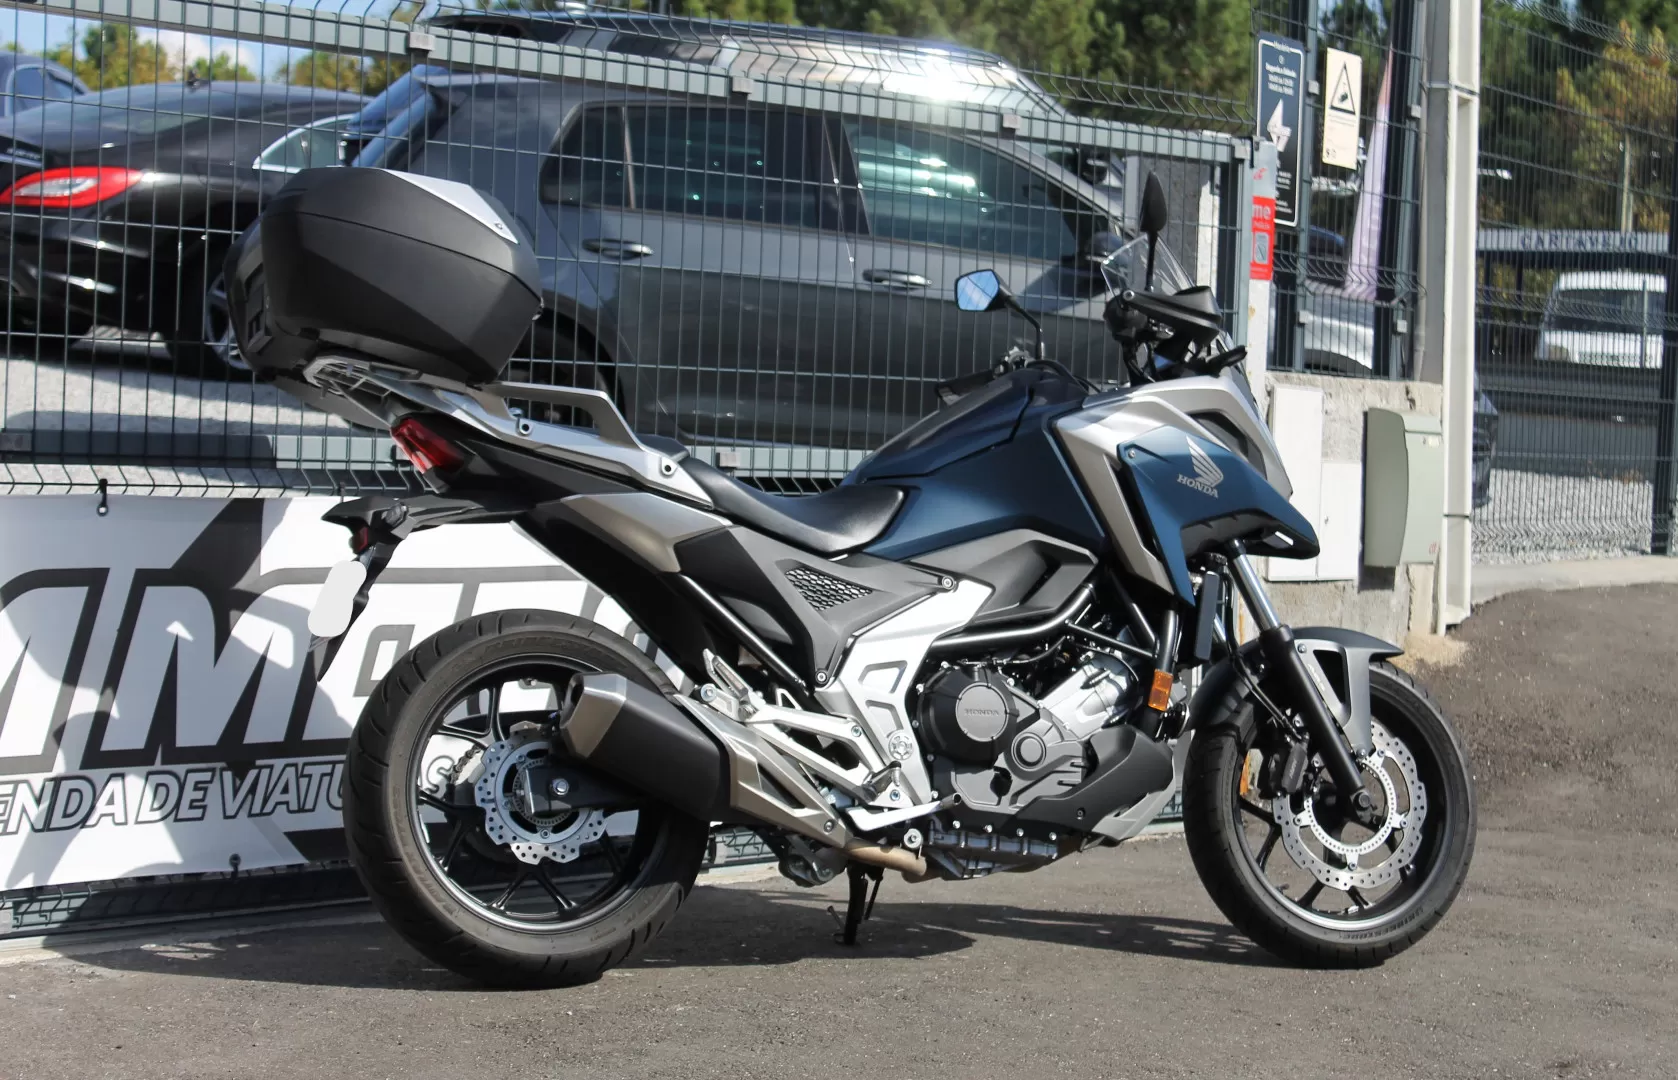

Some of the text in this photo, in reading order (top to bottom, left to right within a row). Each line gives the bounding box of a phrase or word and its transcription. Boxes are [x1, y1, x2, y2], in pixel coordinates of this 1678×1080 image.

[1176, 473, 1219, 499] HONDA
[963, 707, 999, 717] HONDA
[134, 767, 217, 825] DE
